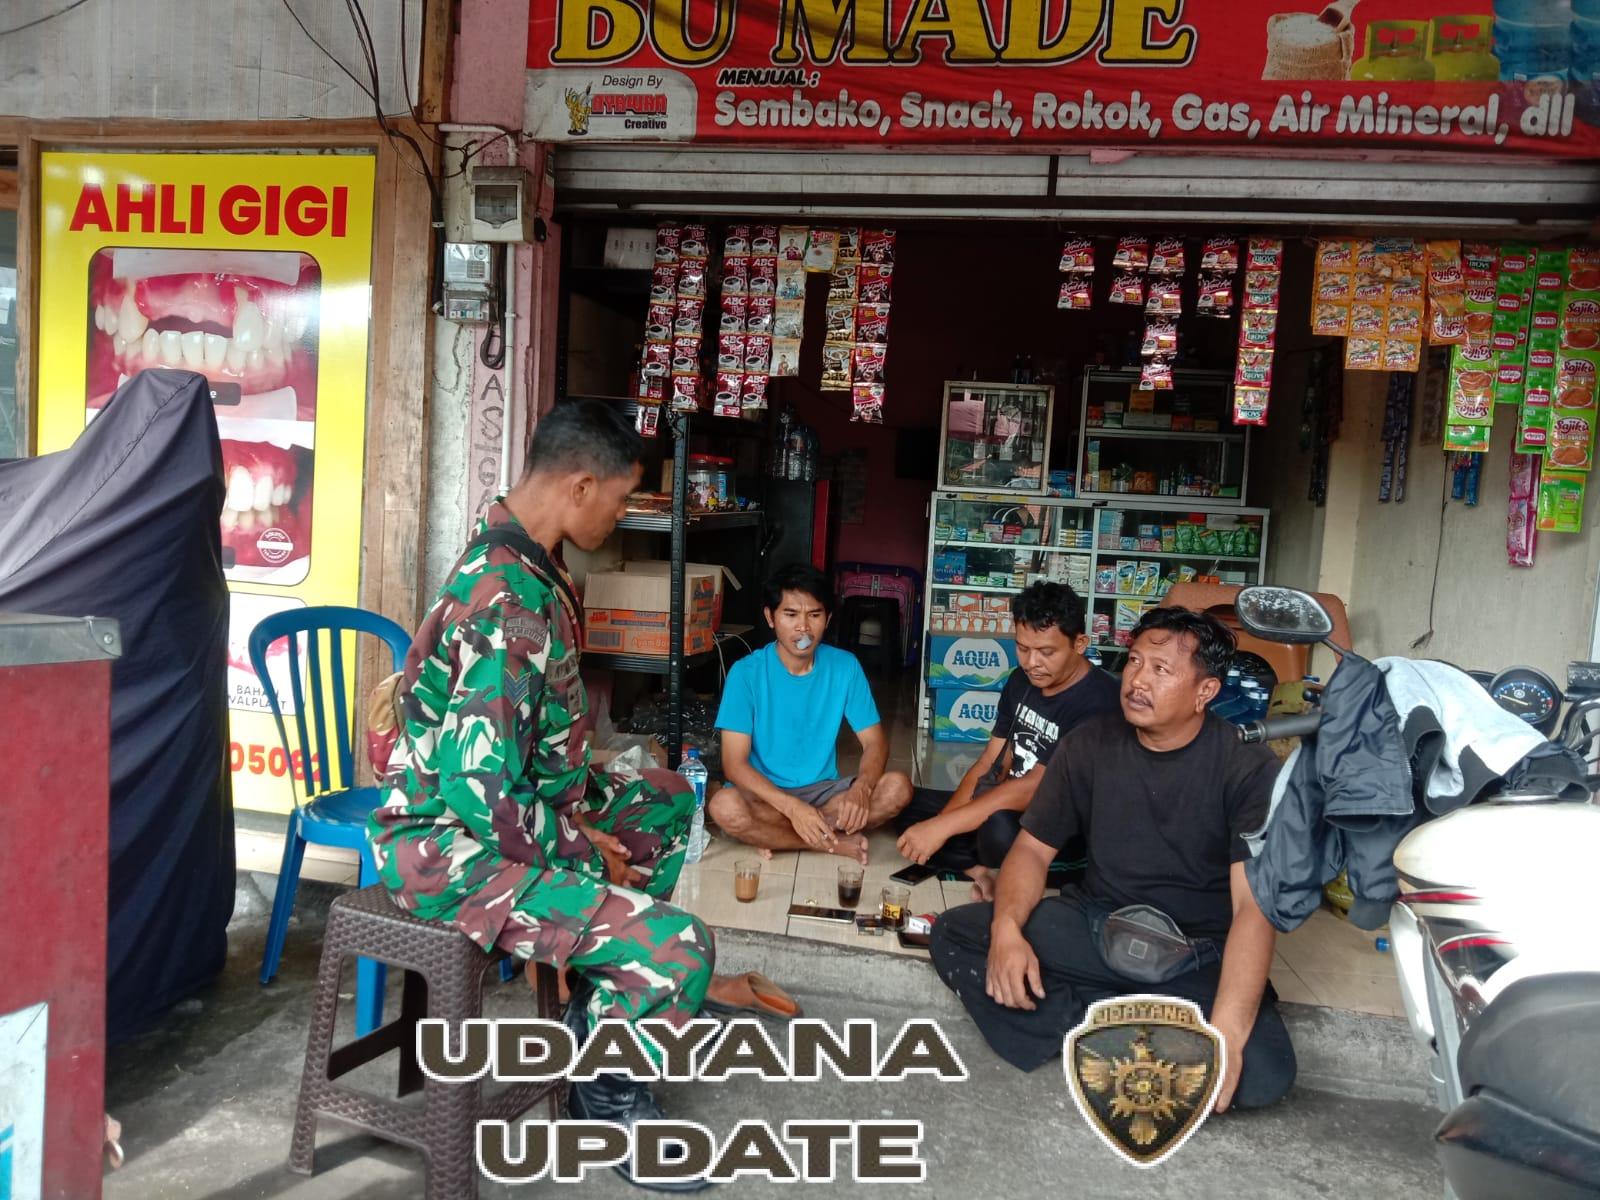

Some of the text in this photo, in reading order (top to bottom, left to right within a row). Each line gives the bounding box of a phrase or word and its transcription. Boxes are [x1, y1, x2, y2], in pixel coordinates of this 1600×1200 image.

[770, 0, 1197, 68] MADE
[602, 75, 664, 89] Design By
[714, 89, 1576, 144] Sembako, Snack, Rokok, Gas, Air Mineral, dll
[624, 118, 668, 129] Creative
[69, 183, 349, 238] AHLI GIGI
[680, 260, 704, 270] ABC
[726, 258, 748, 267] ABC
[753, 258, 775, 267] ABC
[1431, 266, 1461, 281] Sajiku
[724, 297, 746, 306] ABC
[751, 297, 772, 306] ABC
[721, 335, 745, 345] ABC
[749, 337, 770, 346] ABC
[1564, 360, 1595, 376] Sajiku
[674, 376, 697, 385] ABC
[1555, 420, 1589, 434] Sajiku
[952, 650, 1000, 670] AQUA
[958, 703, 998, 723] AQU
